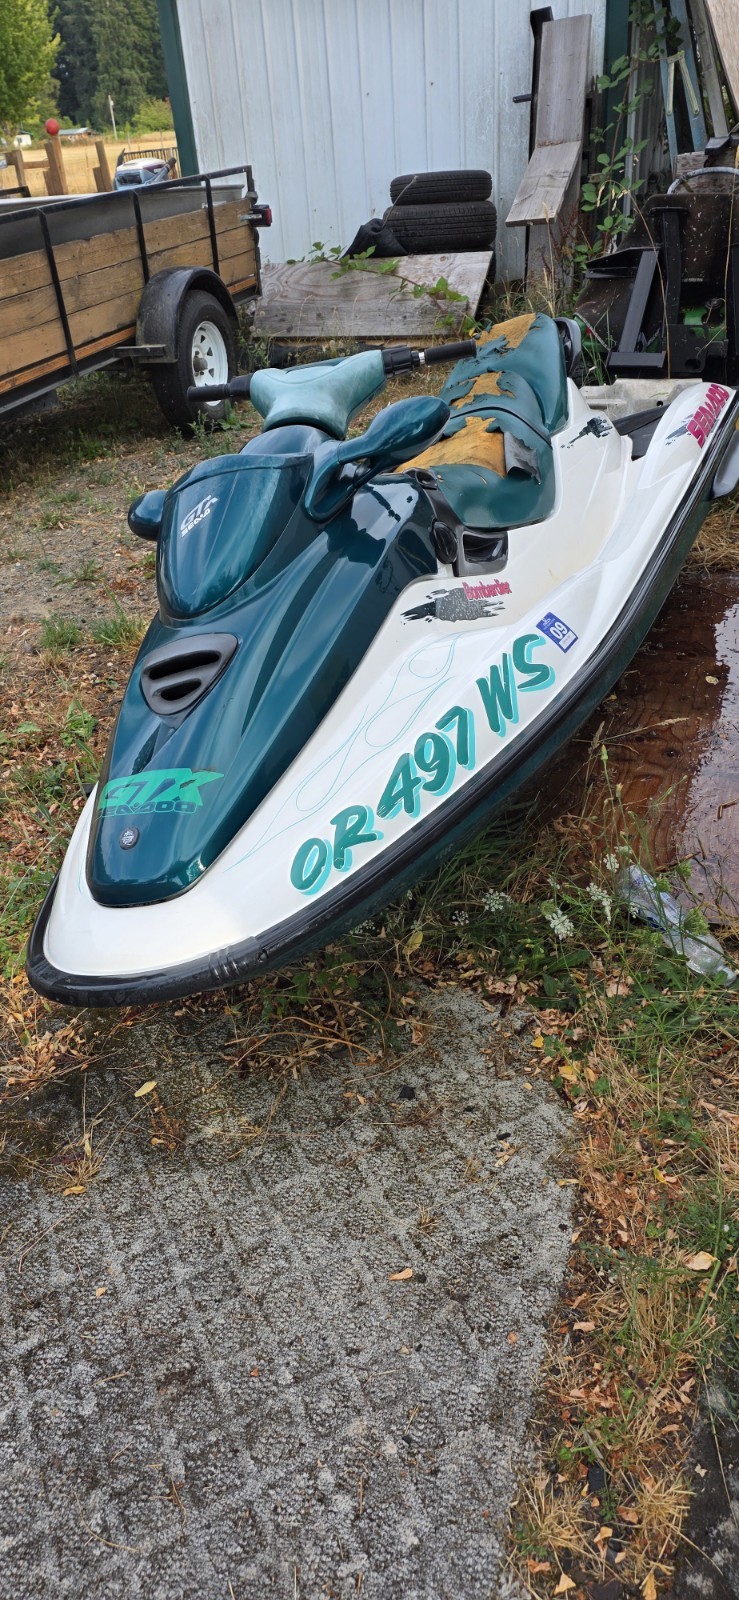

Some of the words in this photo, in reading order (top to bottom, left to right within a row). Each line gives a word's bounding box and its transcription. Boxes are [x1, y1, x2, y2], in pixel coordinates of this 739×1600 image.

[462, 579, 513, 601] Bombardier
[550, 622, 568, 640] 09
[290, 805, 384, 895] OR
[376, 705, 476, 820] 497
[476, 634, 556, 737] WS
[98, 768, 225, 810] GTX
